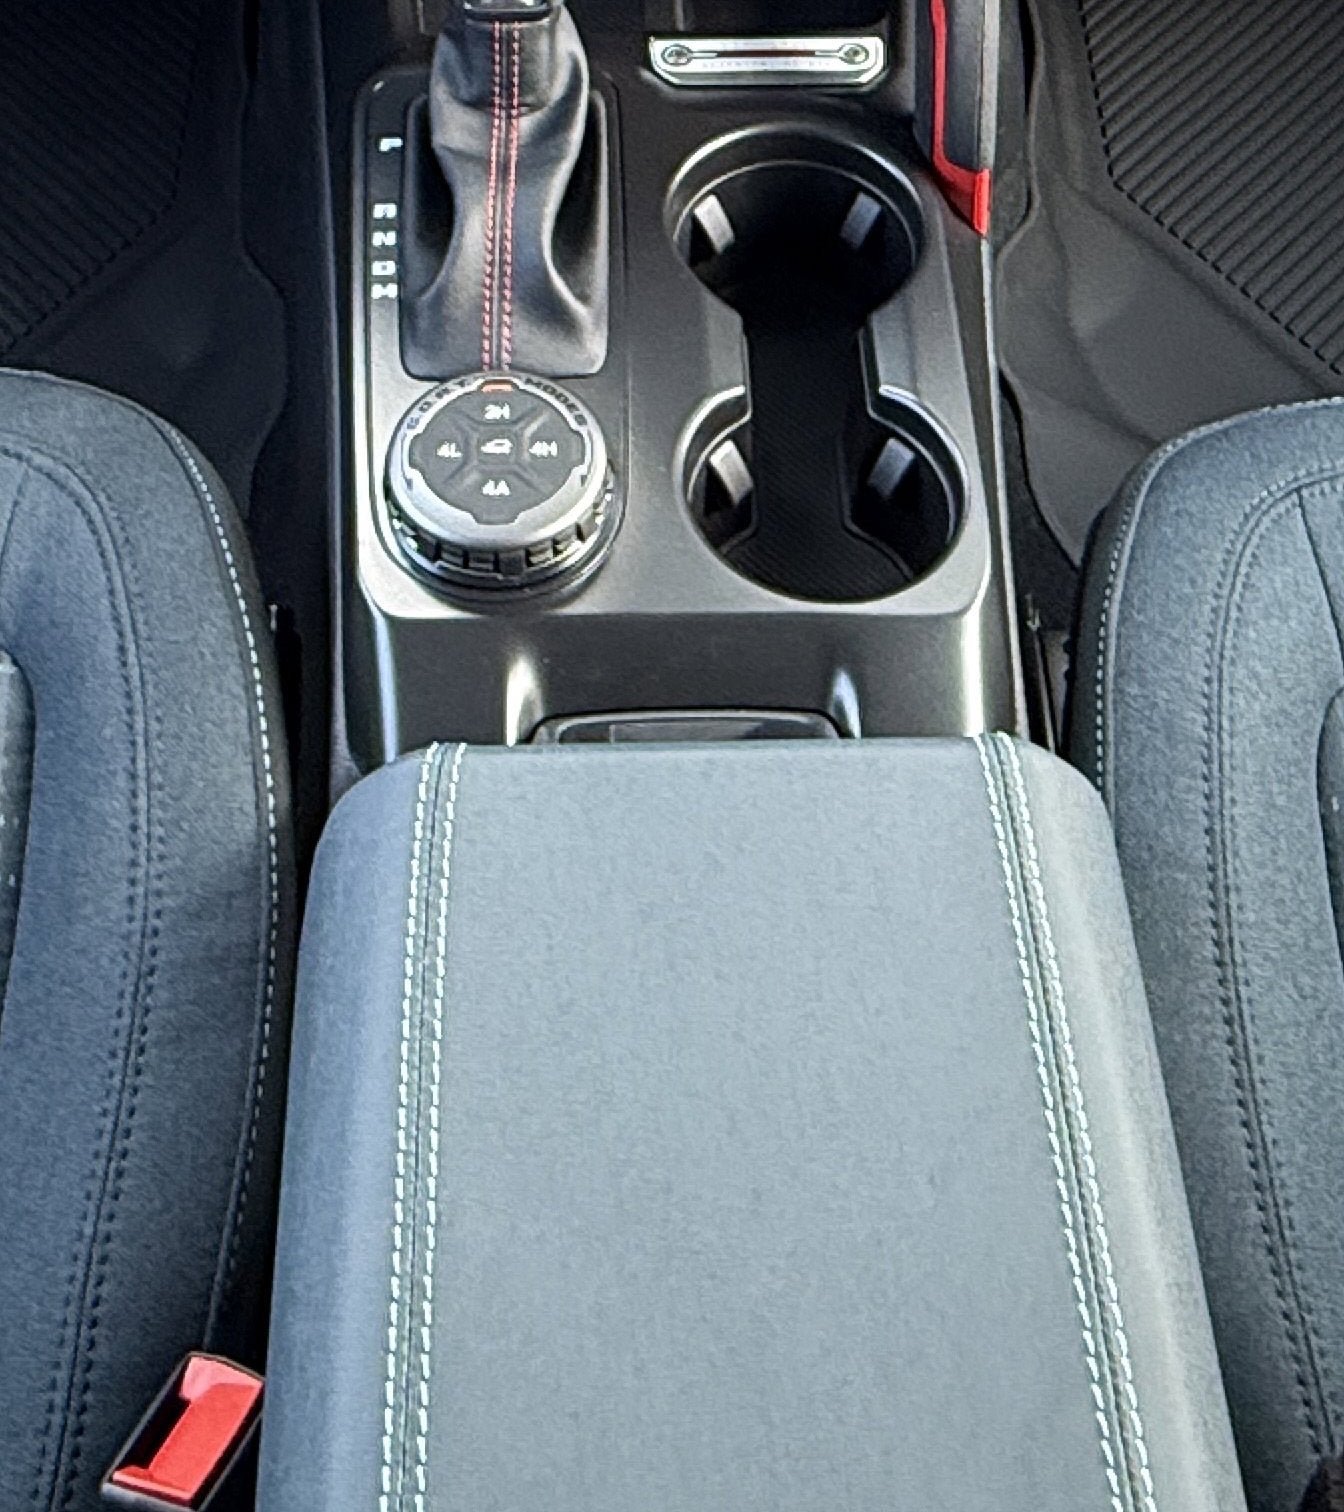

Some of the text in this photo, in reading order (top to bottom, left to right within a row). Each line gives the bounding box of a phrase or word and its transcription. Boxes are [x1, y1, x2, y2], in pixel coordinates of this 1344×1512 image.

[372, 230, 397, 247] N
[371, 260, 396, 276] D
[484, 402, 510, 421] 2H
[436, 441, 463, 458] 4L
[529, 440, 558, 458] 4H
[482, 479, 511, 496] 4A
